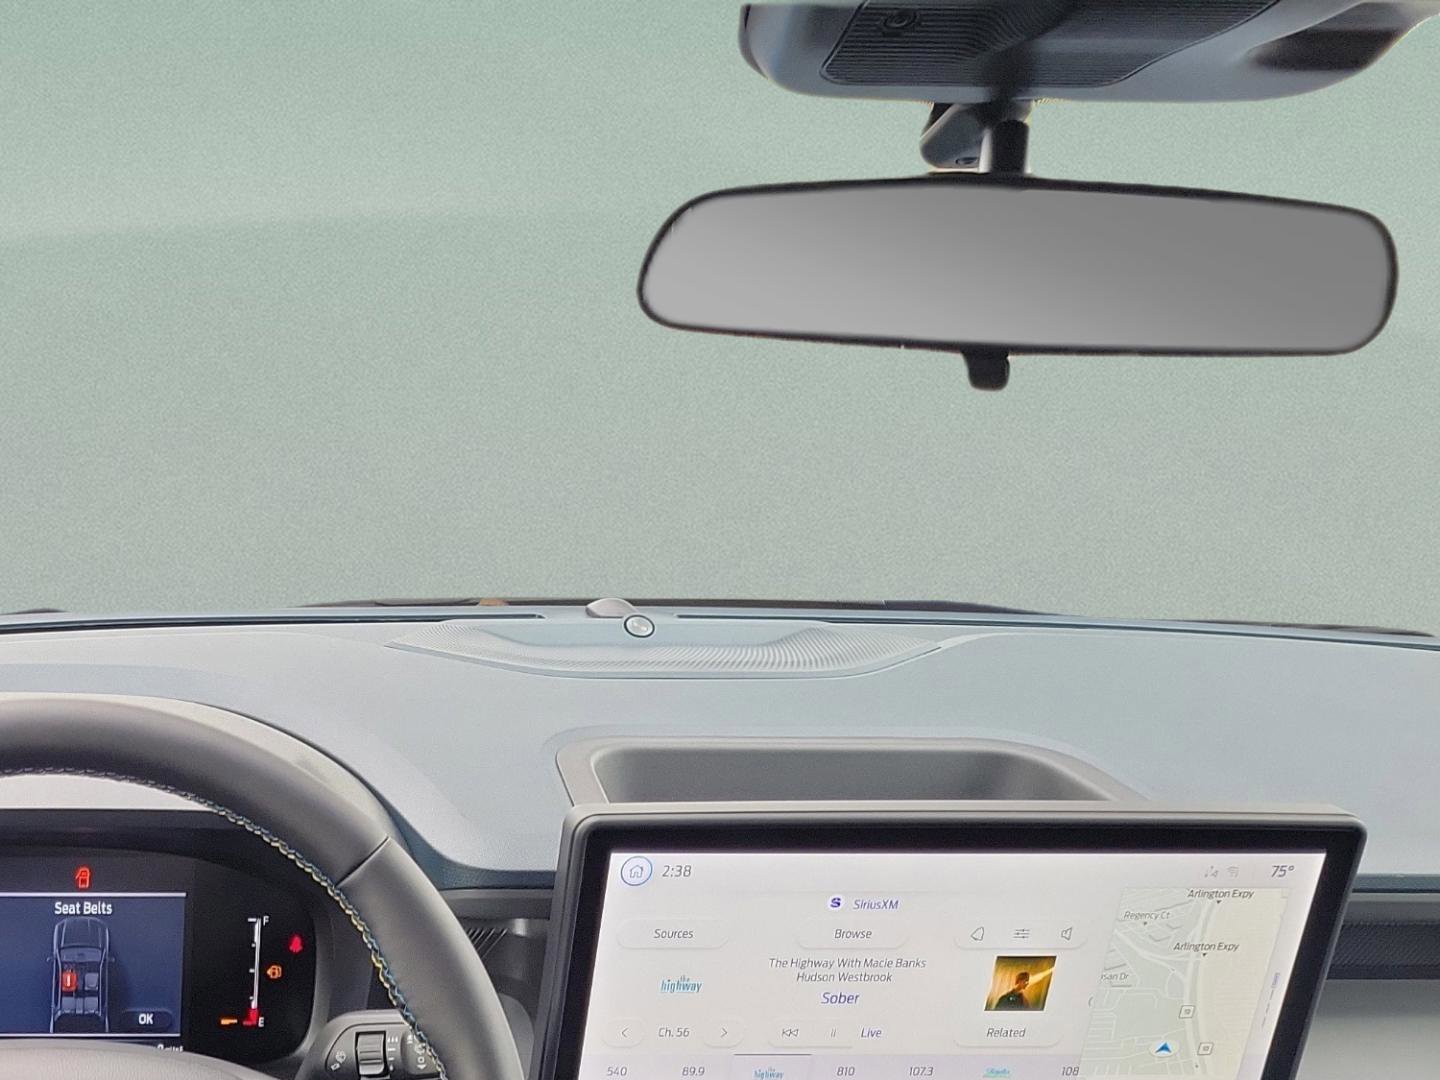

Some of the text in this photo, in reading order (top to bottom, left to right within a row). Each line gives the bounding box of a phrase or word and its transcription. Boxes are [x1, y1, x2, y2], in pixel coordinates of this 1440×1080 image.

[662, 864, 692, 878] 2:38
[1271, 864, 1295, 878] 75°
[1187, 889, 1255, 900] Arlington Expy
[54, 901, 113, 915] Seat Belts
[853, 899, 899, 911] SiriusXM
[263, 915, 269, 926] F
[1123, 911, 1159, 921] Regency
[654, 928, 694, 939] Sources
[834, 928, 872, 939] Browse
[1173, 942, 1240, 953] Arlington Expy
[769, 957, 926, 973] The Highway With Macie Banks
[796, 971, 893, 983] Hudson Westbrook
[660, 979, 703, 993] highway
[821, 991, 860, 1005] Sober
[138, 1013, 154, 1025] OK
[258, 1016, 265, 1027] E
[658, 1027, 691, 1038] Ch. 56
[861, 1027, 882, 1038] Live
[986, 1027, 1026, 1038] Related
[607, 1065, 628, 1077] 540
[681, 1065, 705, 1077] 89.9
[836, 1065, 855, 1077] 810
[908, 1065, 934, 1077] 107.3
[1061, 1065, 1080, 1077] 108
